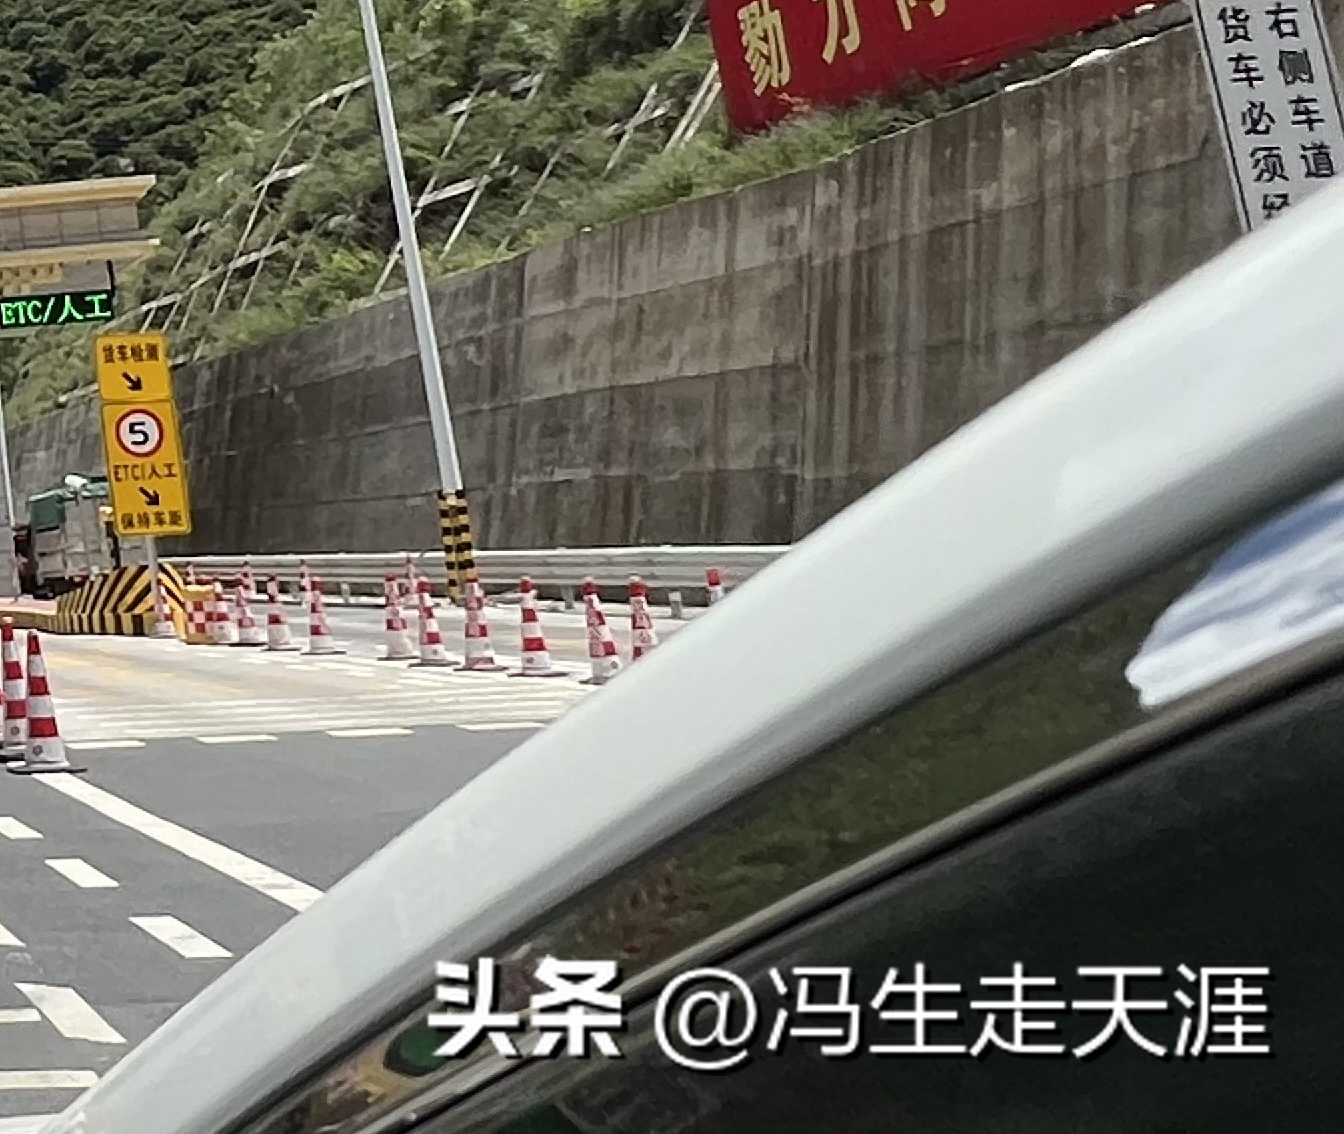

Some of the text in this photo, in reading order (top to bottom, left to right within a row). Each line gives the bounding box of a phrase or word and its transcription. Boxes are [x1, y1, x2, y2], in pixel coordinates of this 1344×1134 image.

[1265, 2, 1335, 178] 右侧车道
[0, 294, 112, 324] ETC/人工
[128, 421, 150, 446] 5
